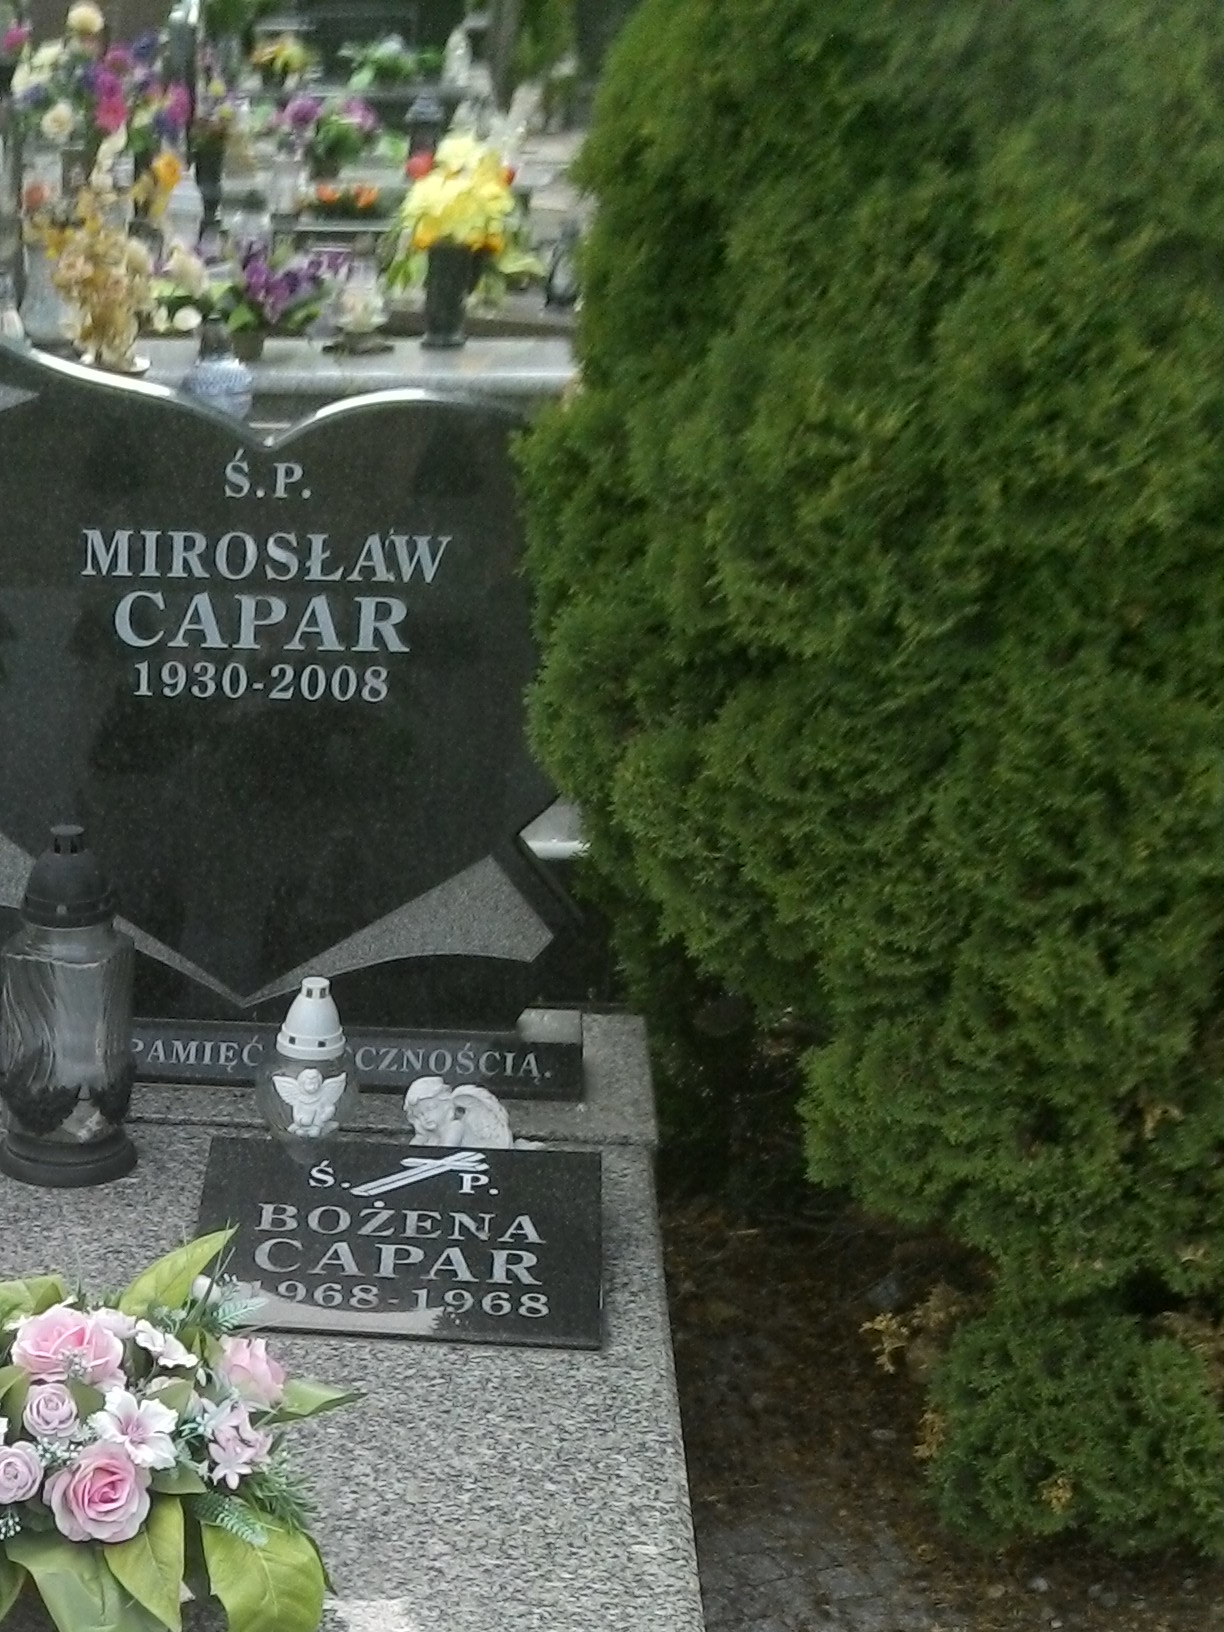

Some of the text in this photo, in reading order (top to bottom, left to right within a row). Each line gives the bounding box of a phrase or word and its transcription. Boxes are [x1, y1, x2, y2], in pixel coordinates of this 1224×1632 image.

[81, 528, 452, 584] MIROSŁAW
[114, 590, 410, 654] CAPAR
[133, 660, 390, 702] 1930-2008
[346, 1042, 552, 1085] CZNOŚCIĄ.
[254, 1200, 547, 1245] BOŻENA
[253, 1238, 543, 1287] CAPAR
